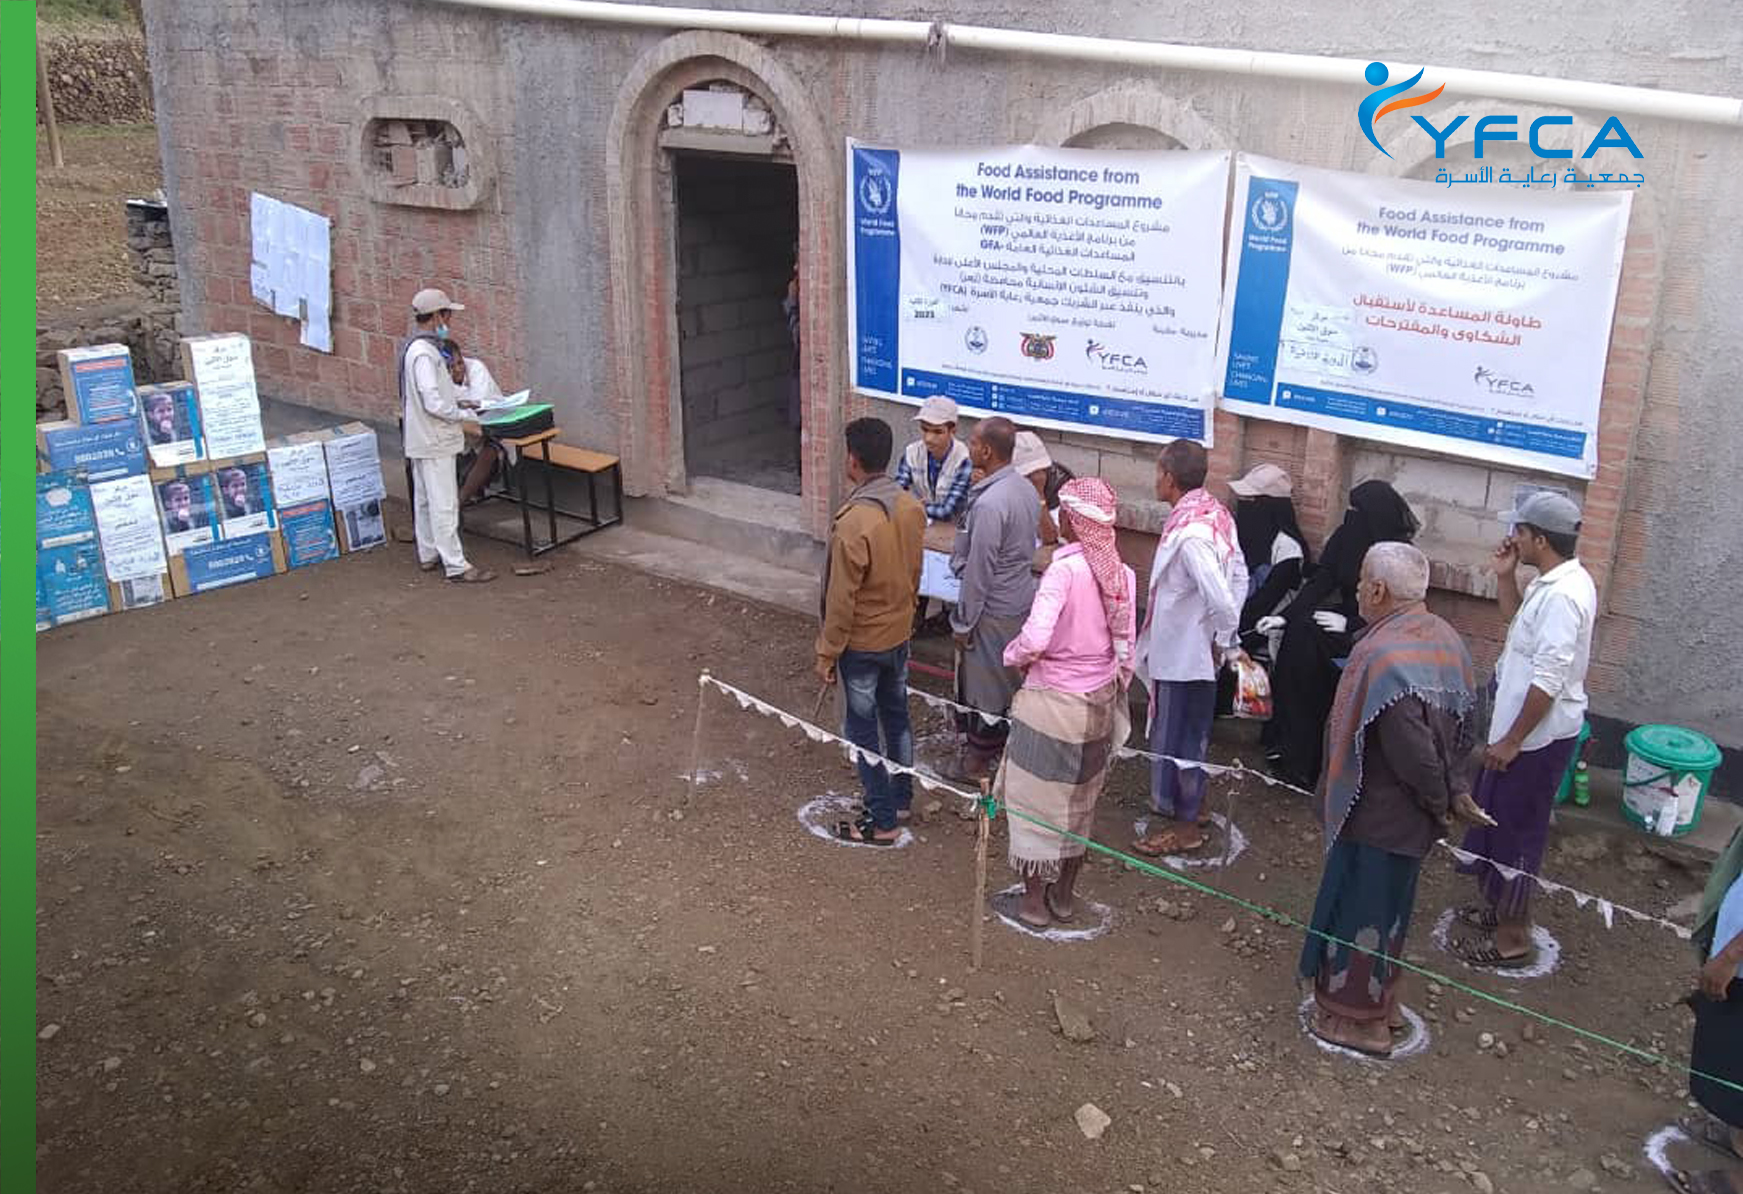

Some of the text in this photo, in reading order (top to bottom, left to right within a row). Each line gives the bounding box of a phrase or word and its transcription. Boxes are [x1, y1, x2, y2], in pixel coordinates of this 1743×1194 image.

[977, 162, 1140, 185] Food Assistance from
[956, 183, 1163, 210] the World Food Programme
[980, 224, 1009, 237] (WFP)
[1075, 215, 1130, 230] المساعدات
[1379, 206, 1546, 234] Food Assistance from
[1356, 221, 1565, 256] the World Food Programme
[1418, 301, 1491, 323] المساعدة
[1494, 310, 1542, 329] طاولة
[1366, 315, 1521, 346] الشكاوى والمقترحات
[1098, 352, 1148, 368] YFCA
[1486, 377, 1535, 394] YFCA
